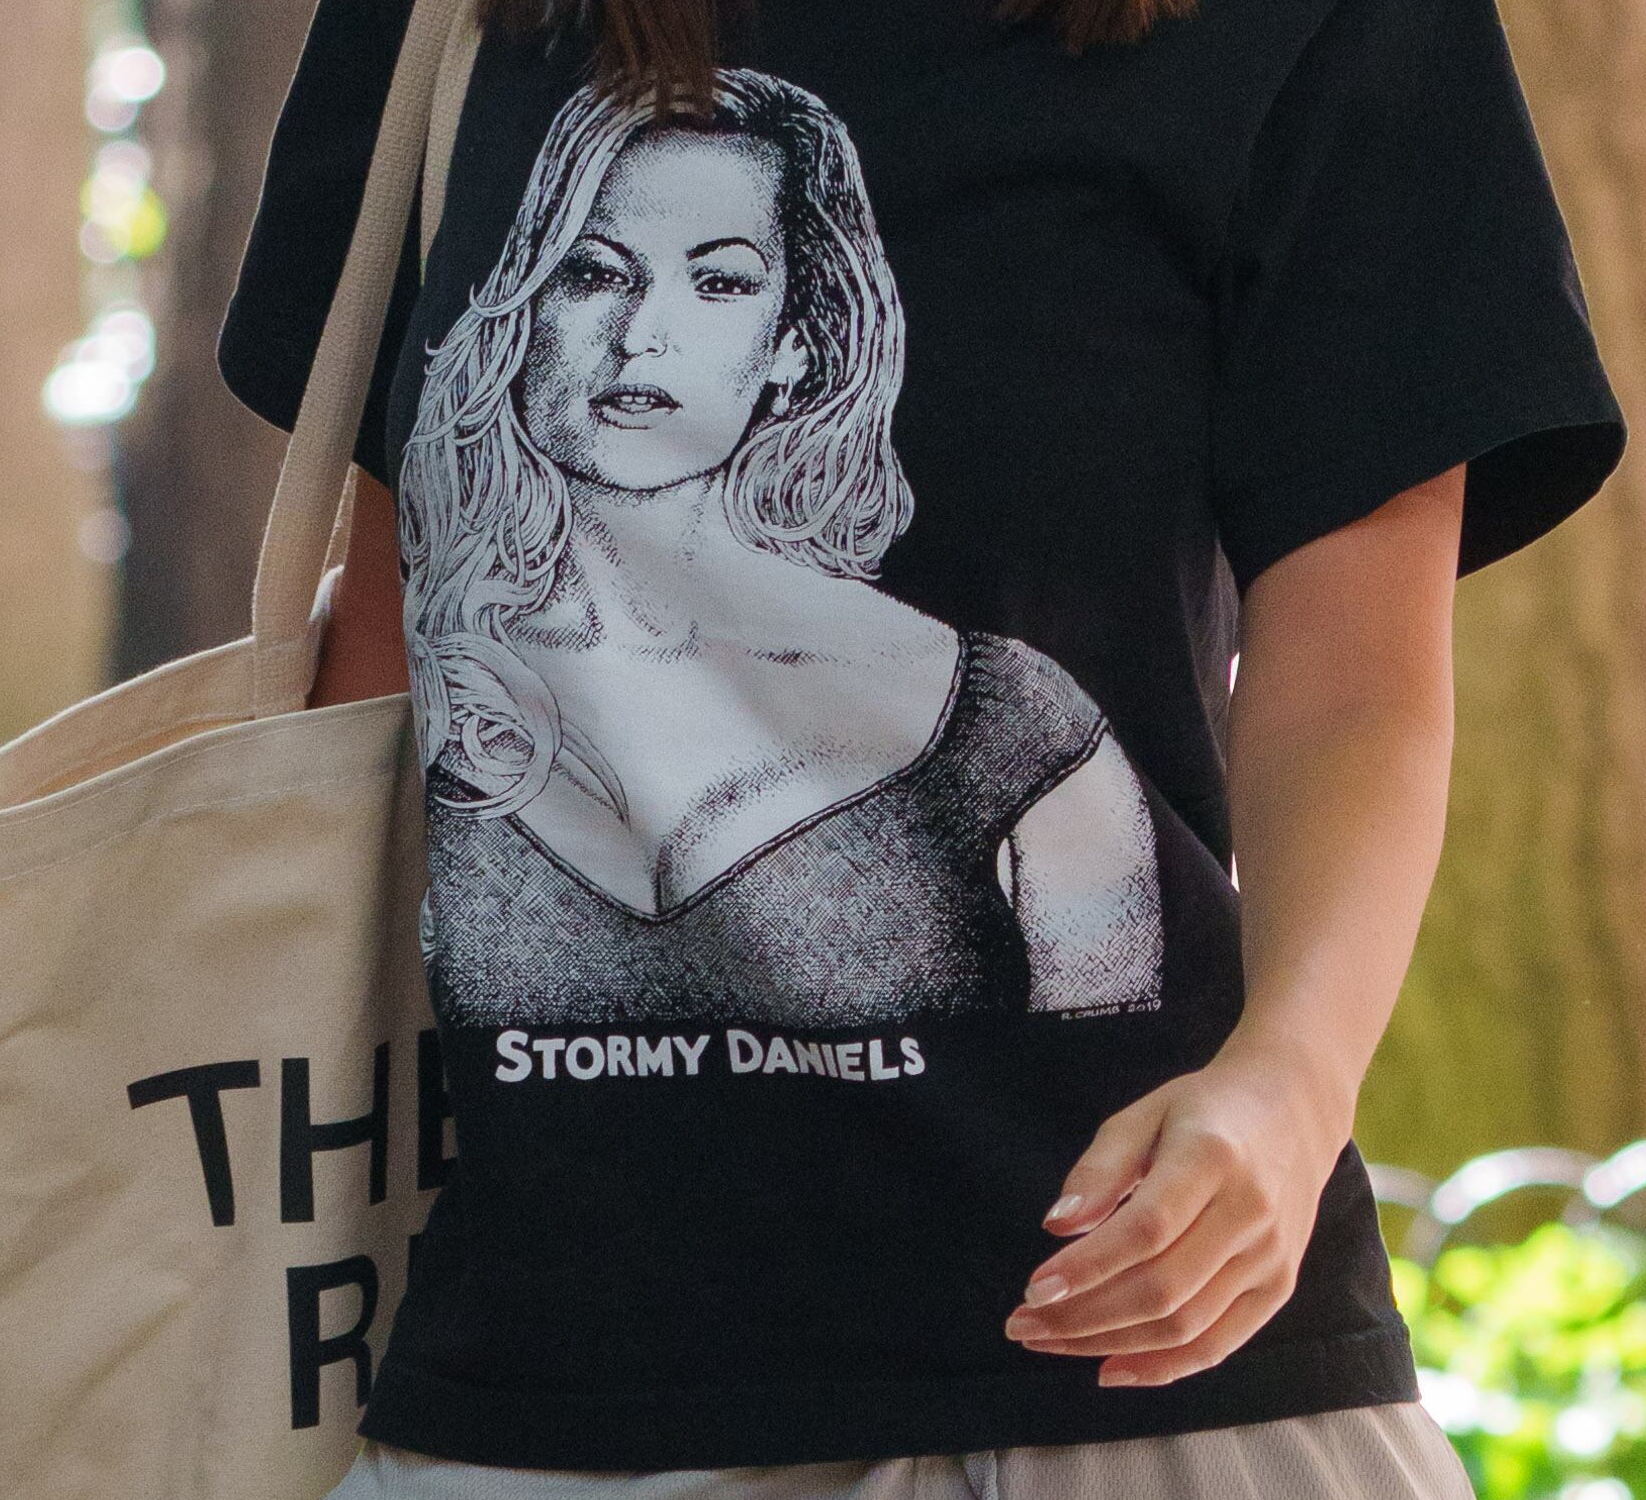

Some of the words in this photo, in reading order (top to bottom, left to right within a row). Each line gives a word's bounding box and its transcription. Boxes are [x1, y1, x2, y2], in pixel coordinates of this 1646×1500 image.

[1127, 998, 1162, 1013] 2019
[494, 1029, 711, 1083] STORMY
[726, 1028, 927, 1082] DANIELS
[286, 1233, 425, 1431] R
